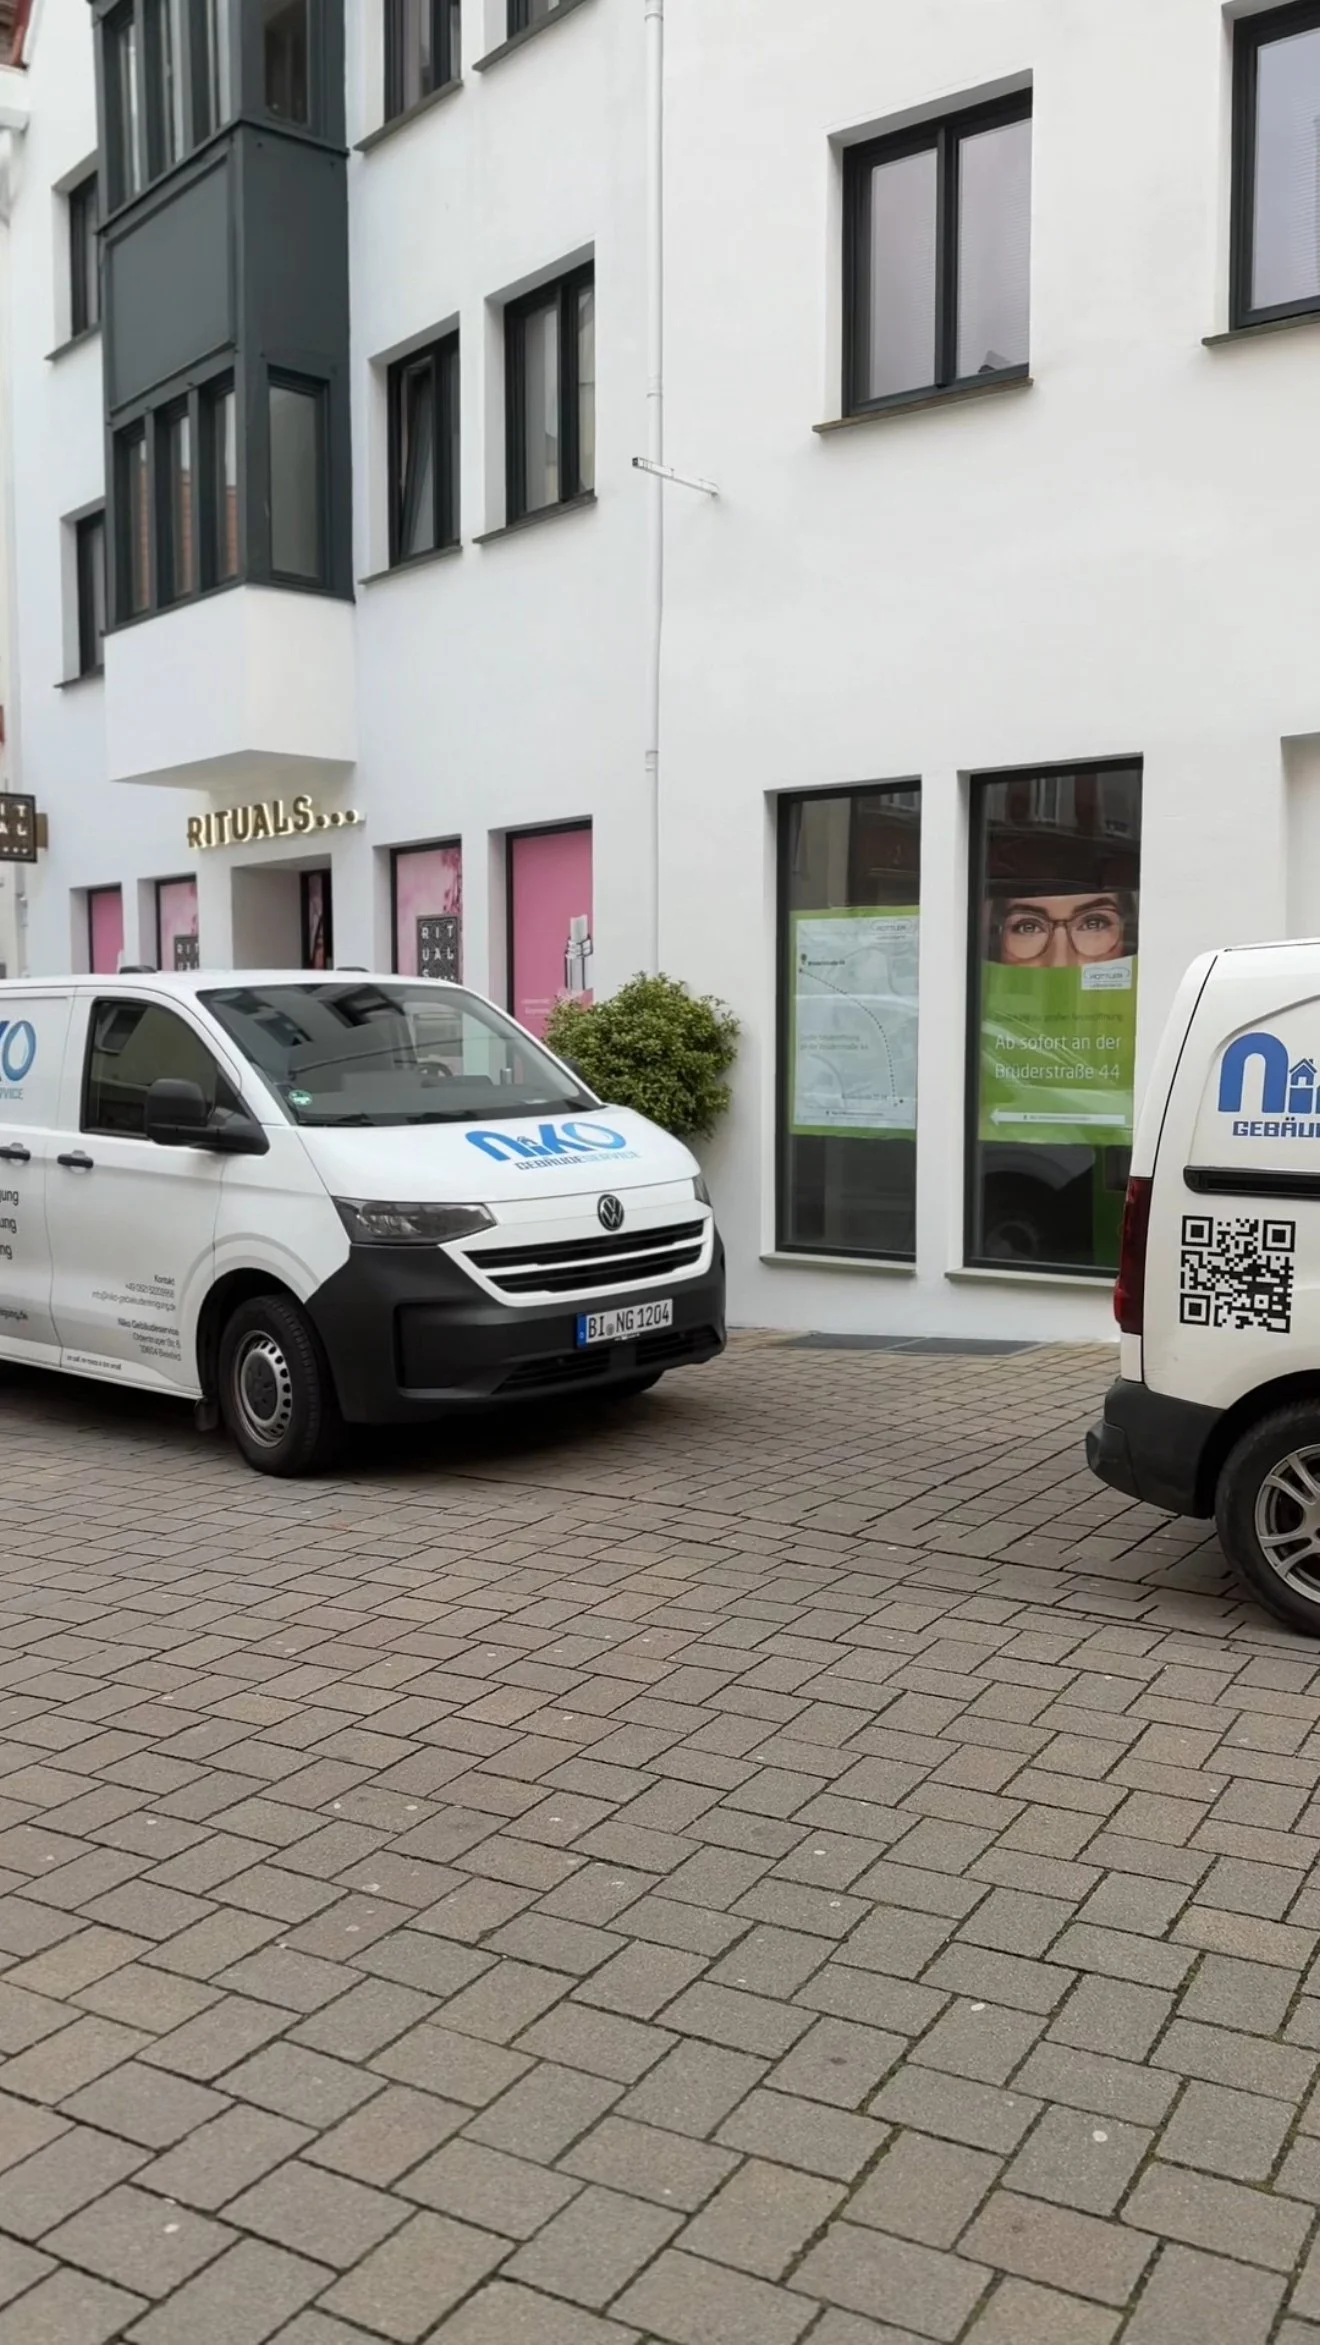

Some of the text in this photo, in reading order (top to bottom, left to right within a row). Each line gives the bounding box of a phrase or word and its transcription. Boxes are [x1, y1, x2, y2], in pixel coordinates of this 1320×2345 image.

[995, 1034, 1122, 1051] Ab sofort an der
[995, 1063, 1120, 1080] Brüderstraße 44
[1232, 1117, 1320, 1138] GEBÄU
[588, 1302, 669, 1339] BI NG 1204
